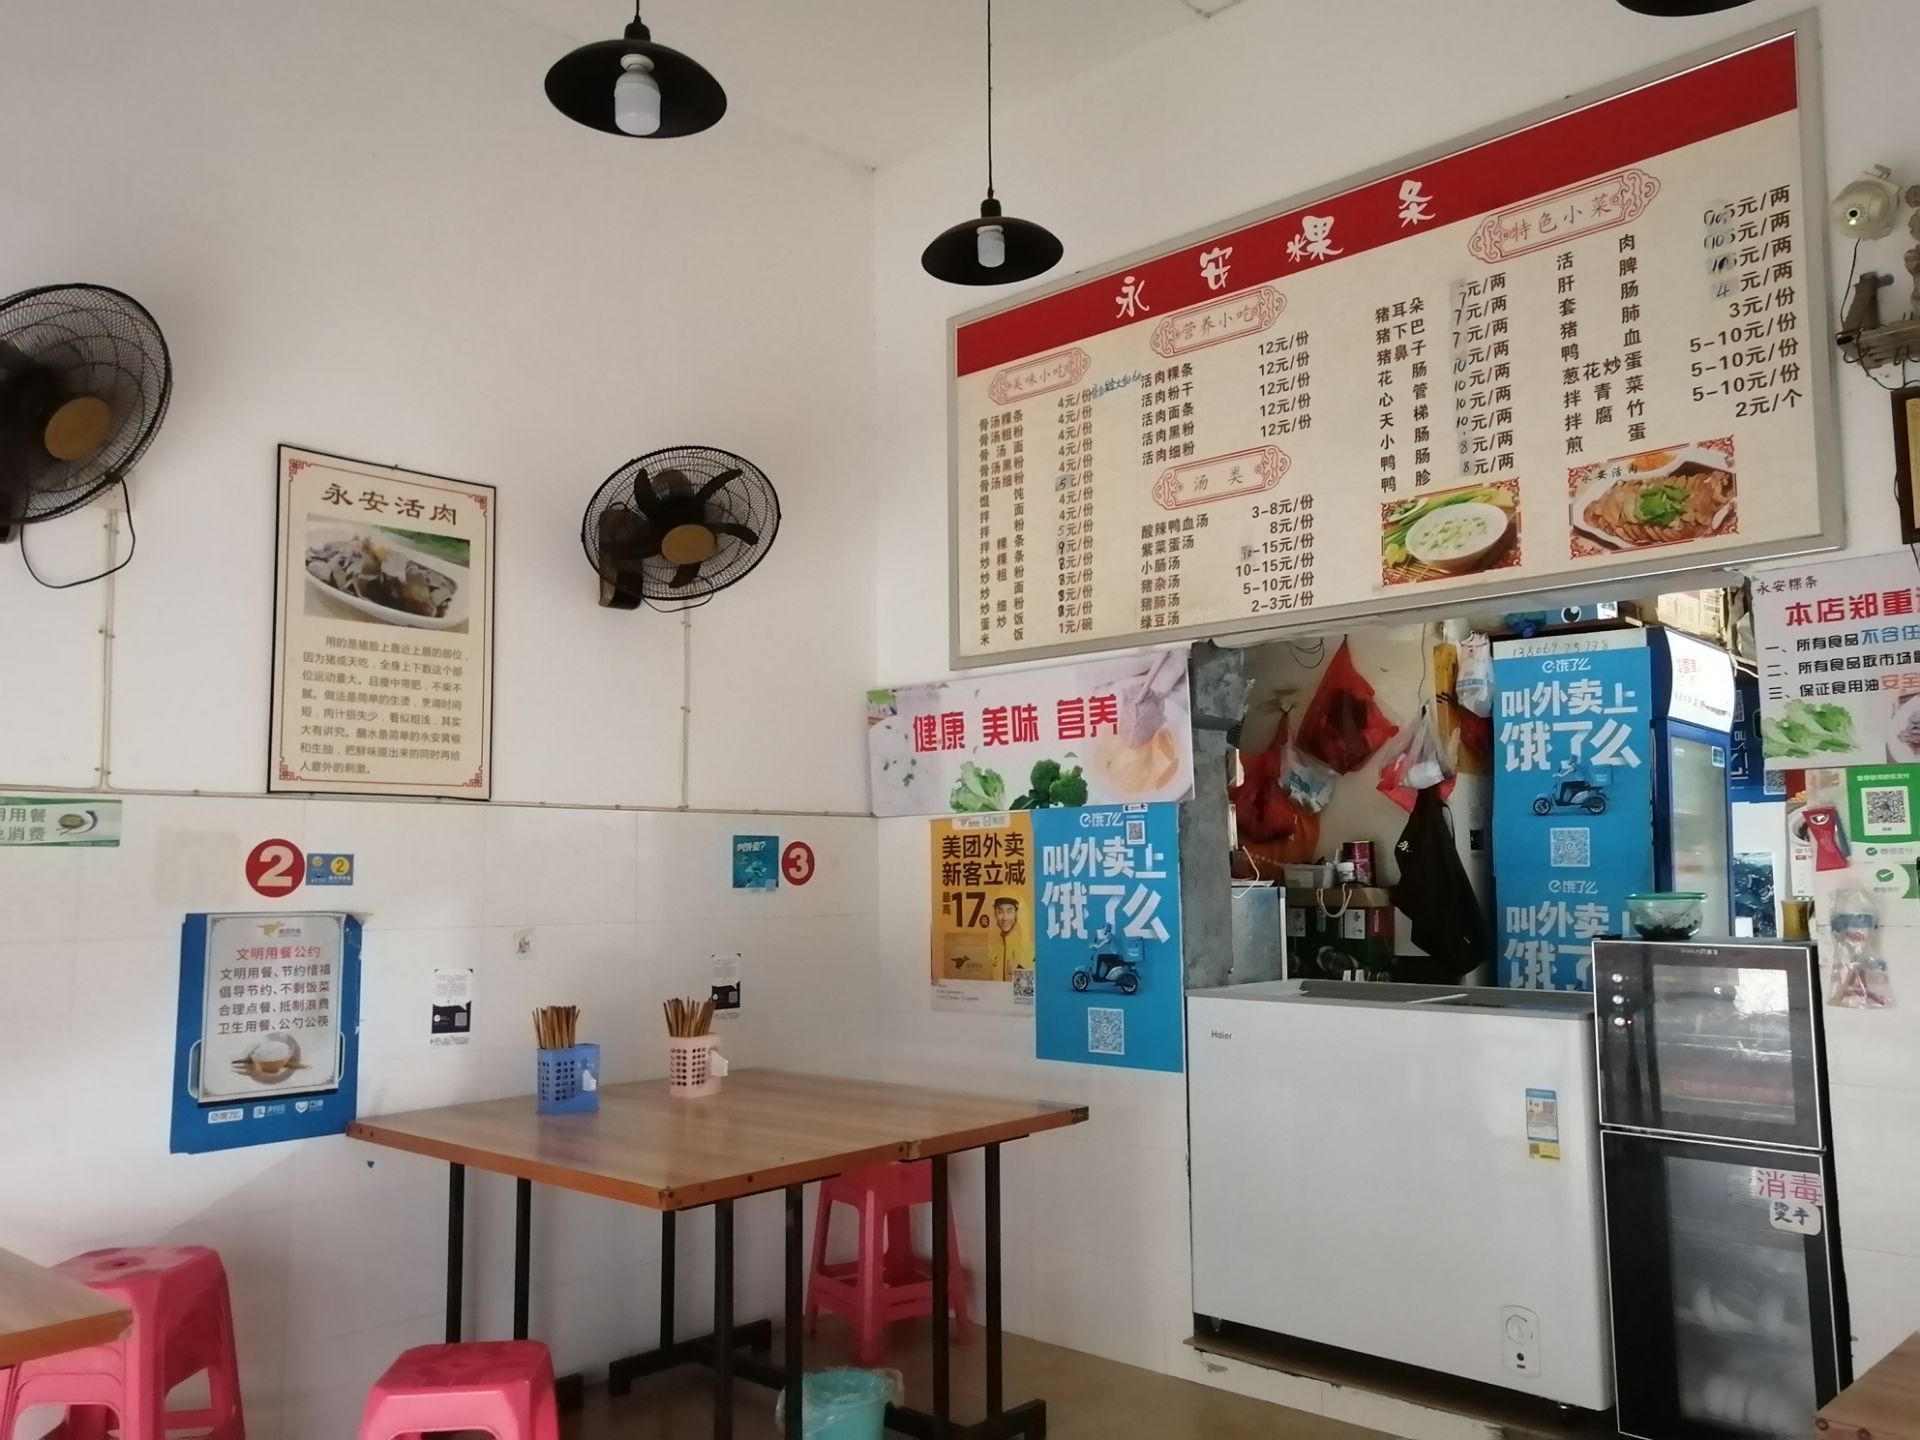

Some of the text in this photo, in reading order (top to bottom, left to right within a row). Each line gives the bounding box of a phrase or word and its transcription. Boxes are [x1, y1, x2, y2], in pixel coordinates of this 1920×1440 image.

[1511, 193, 1613, 242] 特色小菜
[1375, 296, 1425, 324] 猪耳朵
[1730, 286, 1796, 319] 3元/份
[1182, 307, 1254, 341] 营养小吃
[1376, 318, 1426, 345] 猪下巴
[1258, 331, 1309, 356] 12元/份
[1377, 339, 1427, 366] 猪鼻子
[1141, 362, 1193, 389] 活肉粿条
[1259, 351, 1310, 377] 12元/份
[1562, 350, 1644, 386] 葱花炒蛋
[1141, 382, 1194, 408] 活肉粉干
[1260, 372, 1311, 397] 12元/份
[1563, 374, 1645, 409] 拌青菜
[1058, 389, 1094, 408] 4元/份
[1260, 393, 1311, 418] 12元/份
[1736, 388, 1803, 419] 2元/个
[1058, 405, 1094, 424] 4元/份
[1141, 402, 1194, 428] 活肉面条
[1261, 413, 1312, 438] 12元/份
[1564, 398, 1646, 432] 拌腐竹
[1058, 421, 1094, 440] 4元/份
[1142, 421, 1195, 447] 活肉黑粉
[1058, 438, 1094, 456] 4元/份
[1142, 440, 1195, 466] 活肉细粉
[1058, 454, 1094, 472] 4元/份
[321, 483, 458, 526] 永安活肉
[1058, 487, 1094, 505] 4元/份
[1058, 503, 1094, 521] 4元/份
[1270, 513, 1315, 534] 8元/份
[1785, 588, 1920, 626] 本店郑重
[1058, 617, 1094, 634] 1元/碗
[1501, 678, 1638, 718] 叫外卖上
[913, 693, 1118, 753] 健康 美味 营养
[1500, 719, 1642, 772] 饿了么
[941, 832, 1025, 861] 美团外卖
[1042, 836, 1166, 879] 叫外卖上
[257, 845, 294, 887] 2
[335, 859, 346, 873] 2
[789, 847, 809, 880] 3
[941, 860, 1026, 888] 新客立减
[1041, 881, 1170, 944] 饿了么
[236, 946, 321, 961] 文明用餐公约
[219, 963, 331, 980] 文明用餐、节约惜福
[219, 981, 330, 999] 倡导节约、不剩饭菜
[218, 998, 329, 1017] 合理点餐、抵制浪费
[217, 1015, 329, 1035] 卫生用餐、公勺公筷
[1211, 1029, 1233, 1041] Haier
[1756, 1169, 1823, 1207] 消毒
[1773, 1201, 1810, 1224] 烫手
